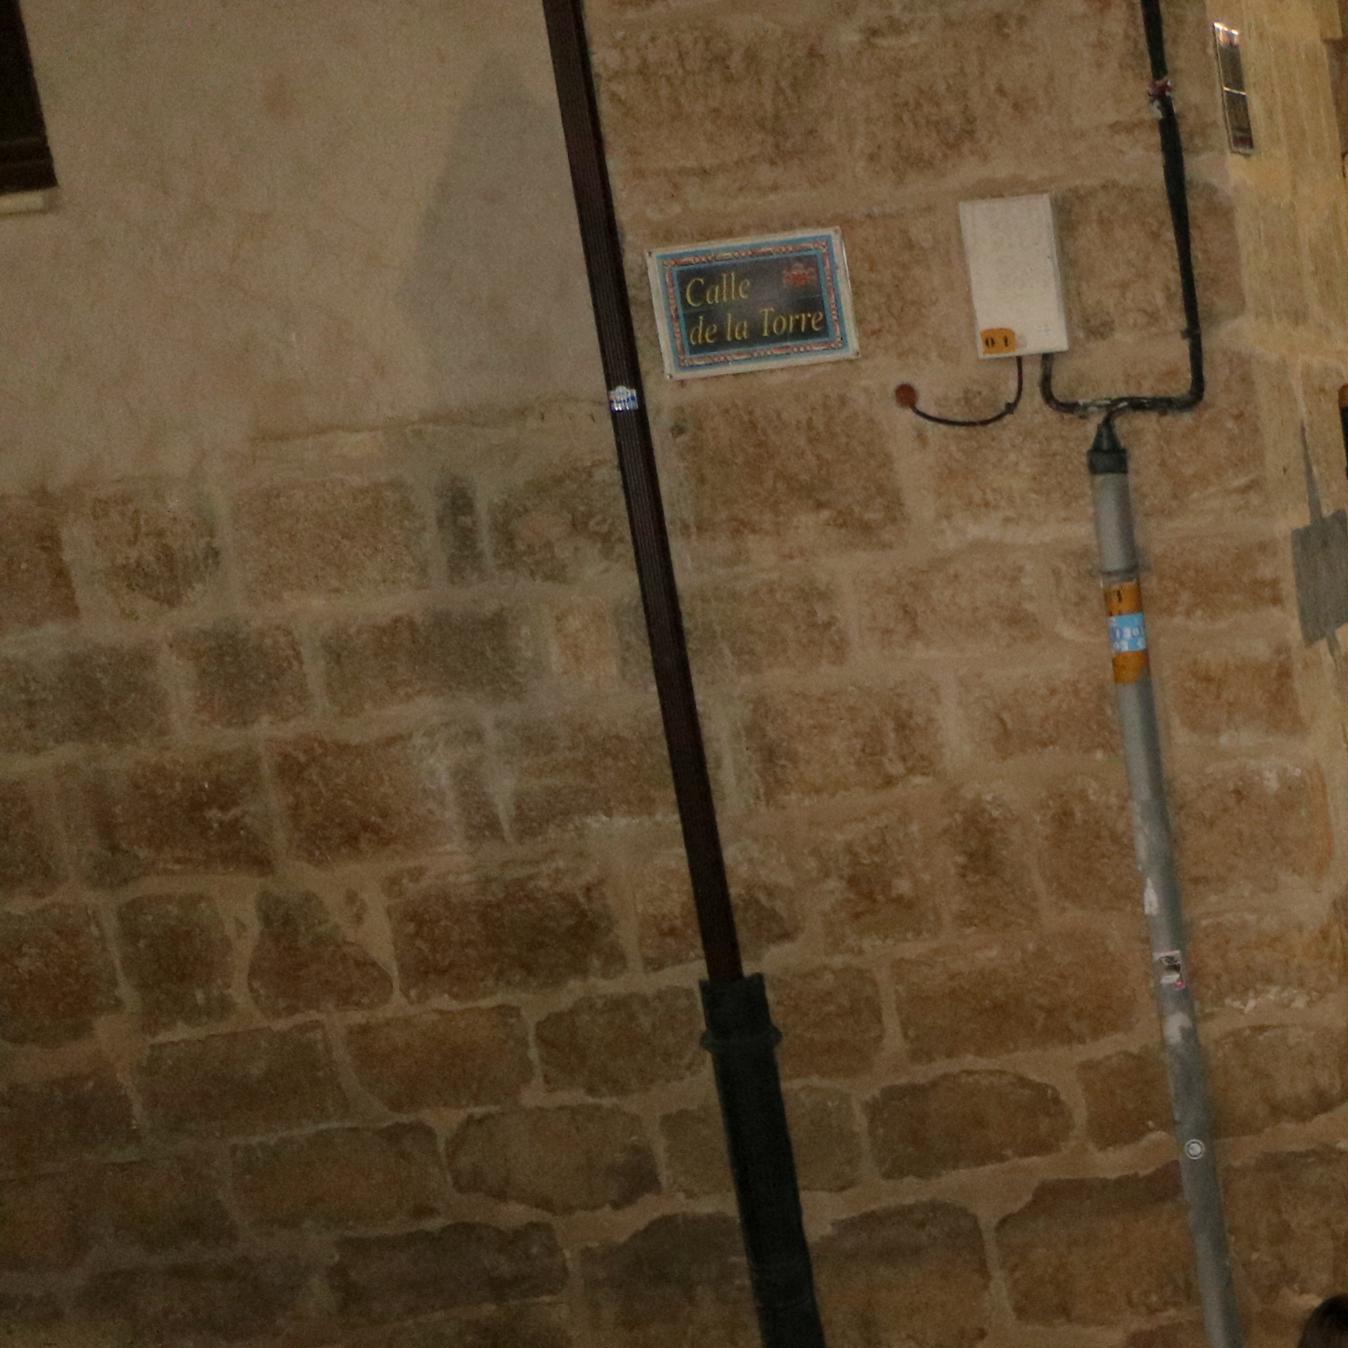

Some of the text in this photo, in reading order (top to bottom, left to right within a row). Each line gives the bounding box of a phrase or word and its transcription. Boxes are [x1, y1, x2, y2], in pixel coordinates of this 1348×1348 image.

[685, 272, 751, 308] Calle
[689, 307, 825, 346] de la Torre
